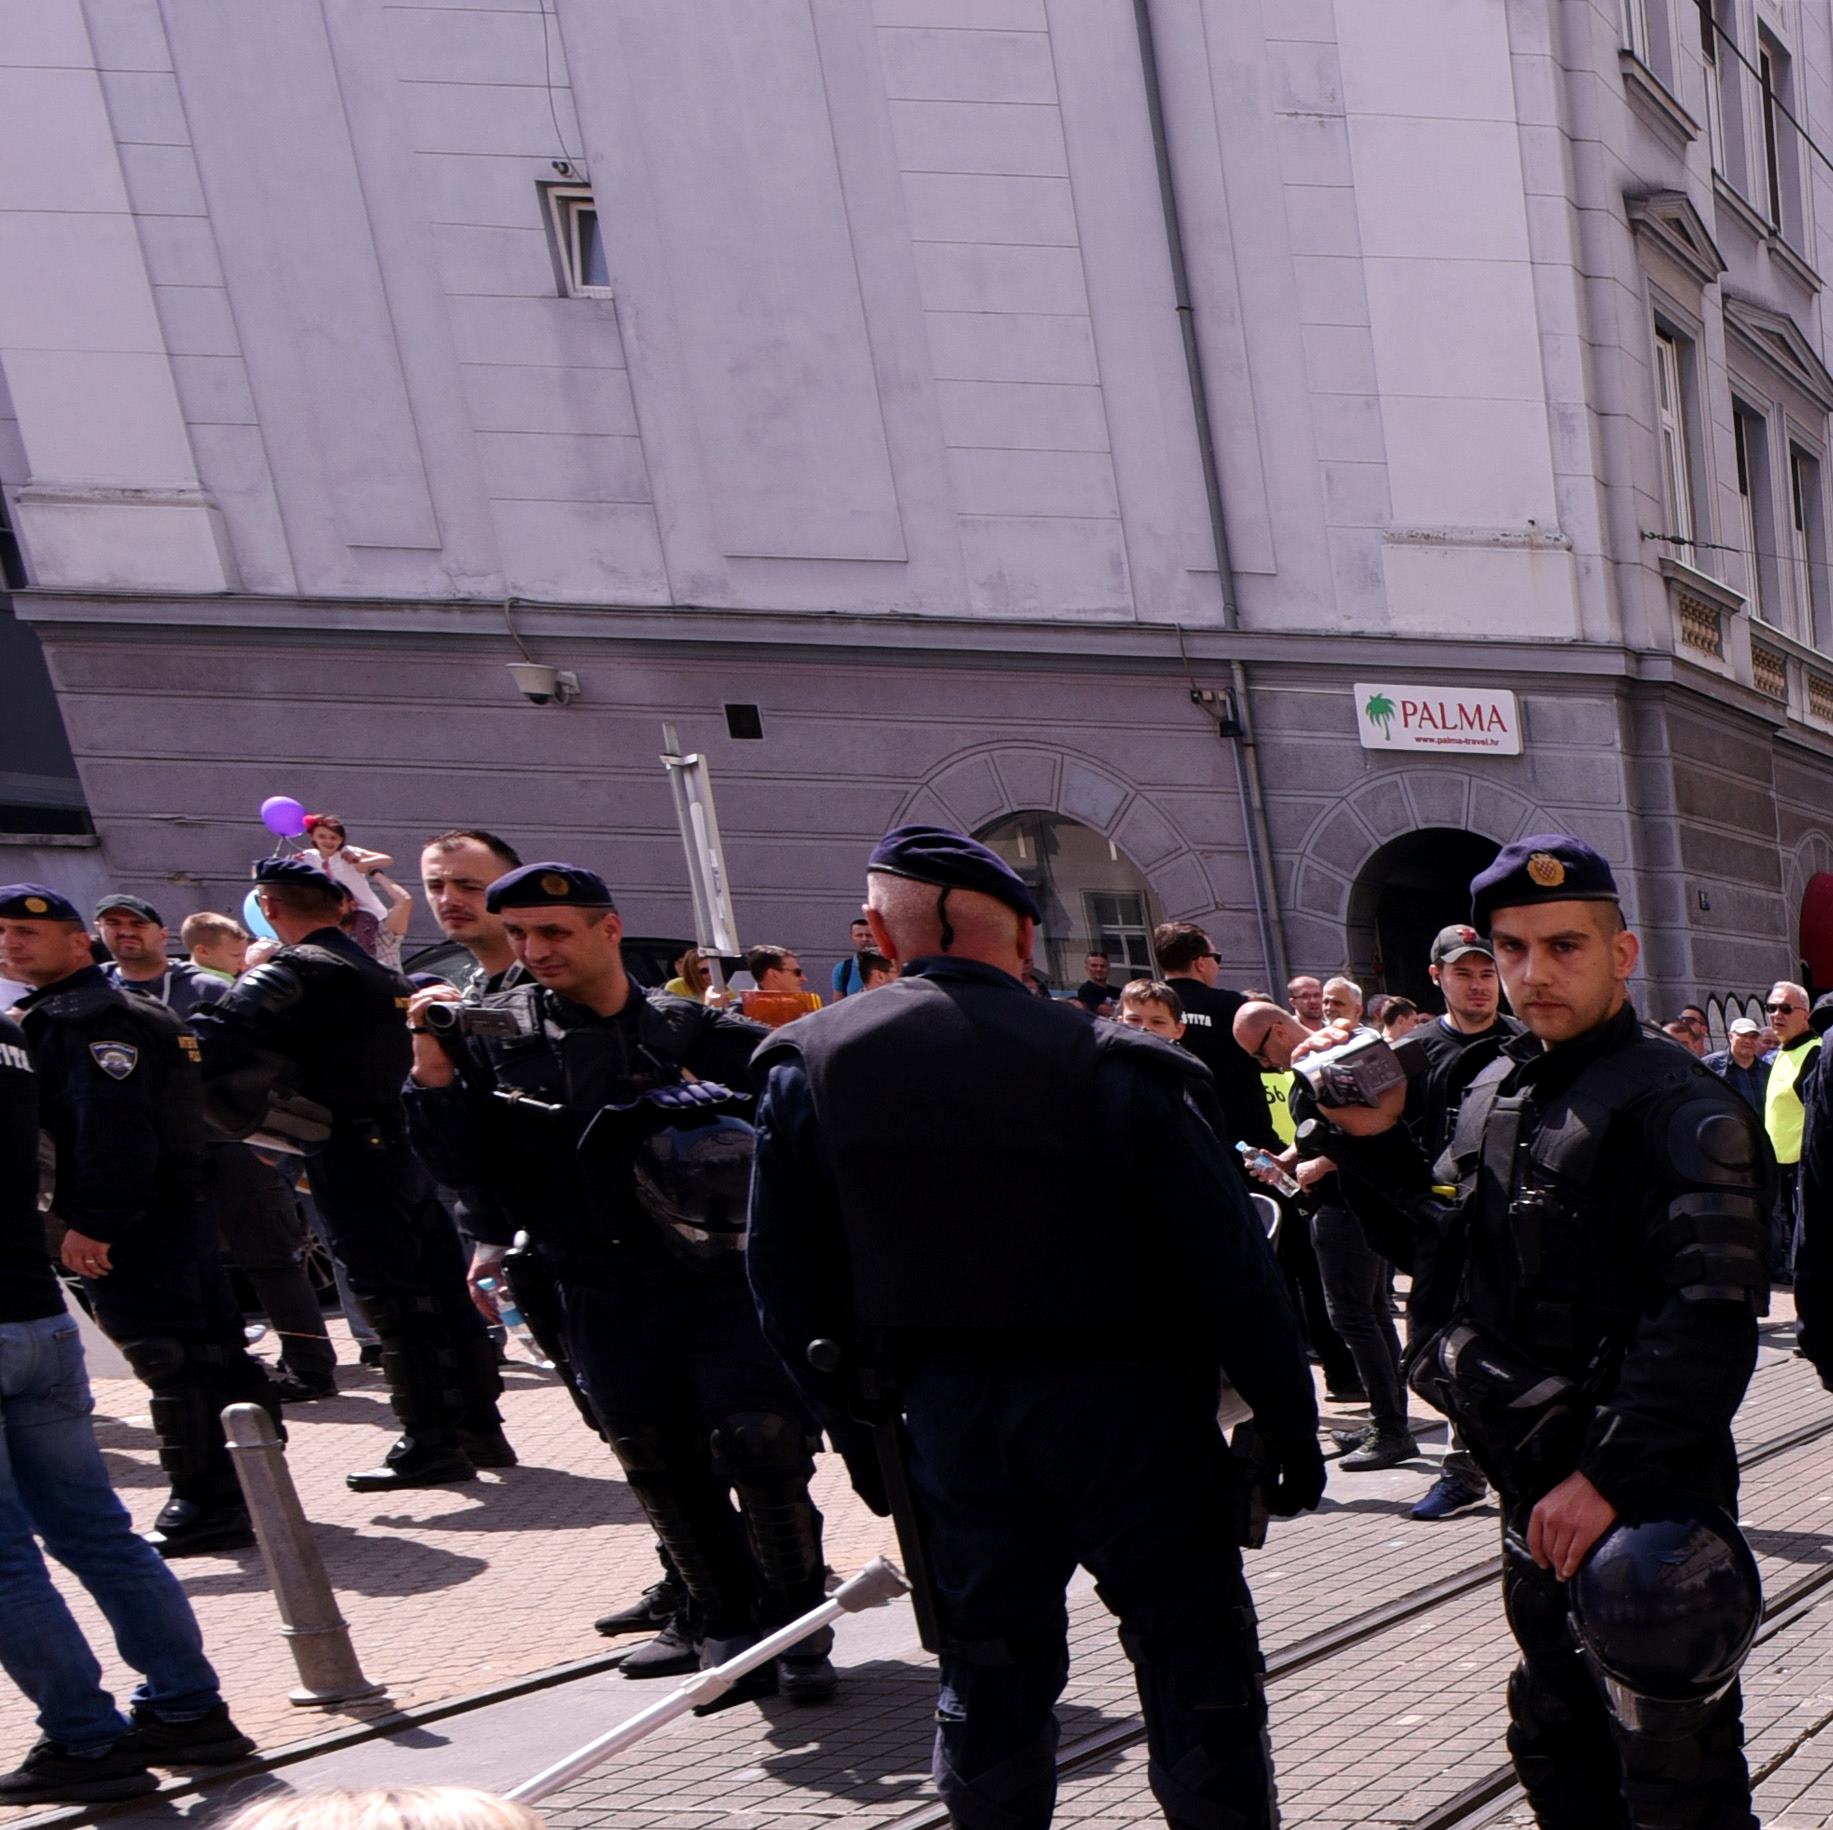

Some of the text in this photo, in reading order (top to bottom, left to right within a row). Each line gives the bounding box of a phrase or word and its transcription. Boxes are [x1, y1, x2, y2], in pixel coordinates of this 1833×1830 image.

[1400, 699, 1508, 733] PALMA
[1414, 735, 1500, 747] www.palma-travel.hr
[1180, 1011, 1213, 1027] ŠTITA
